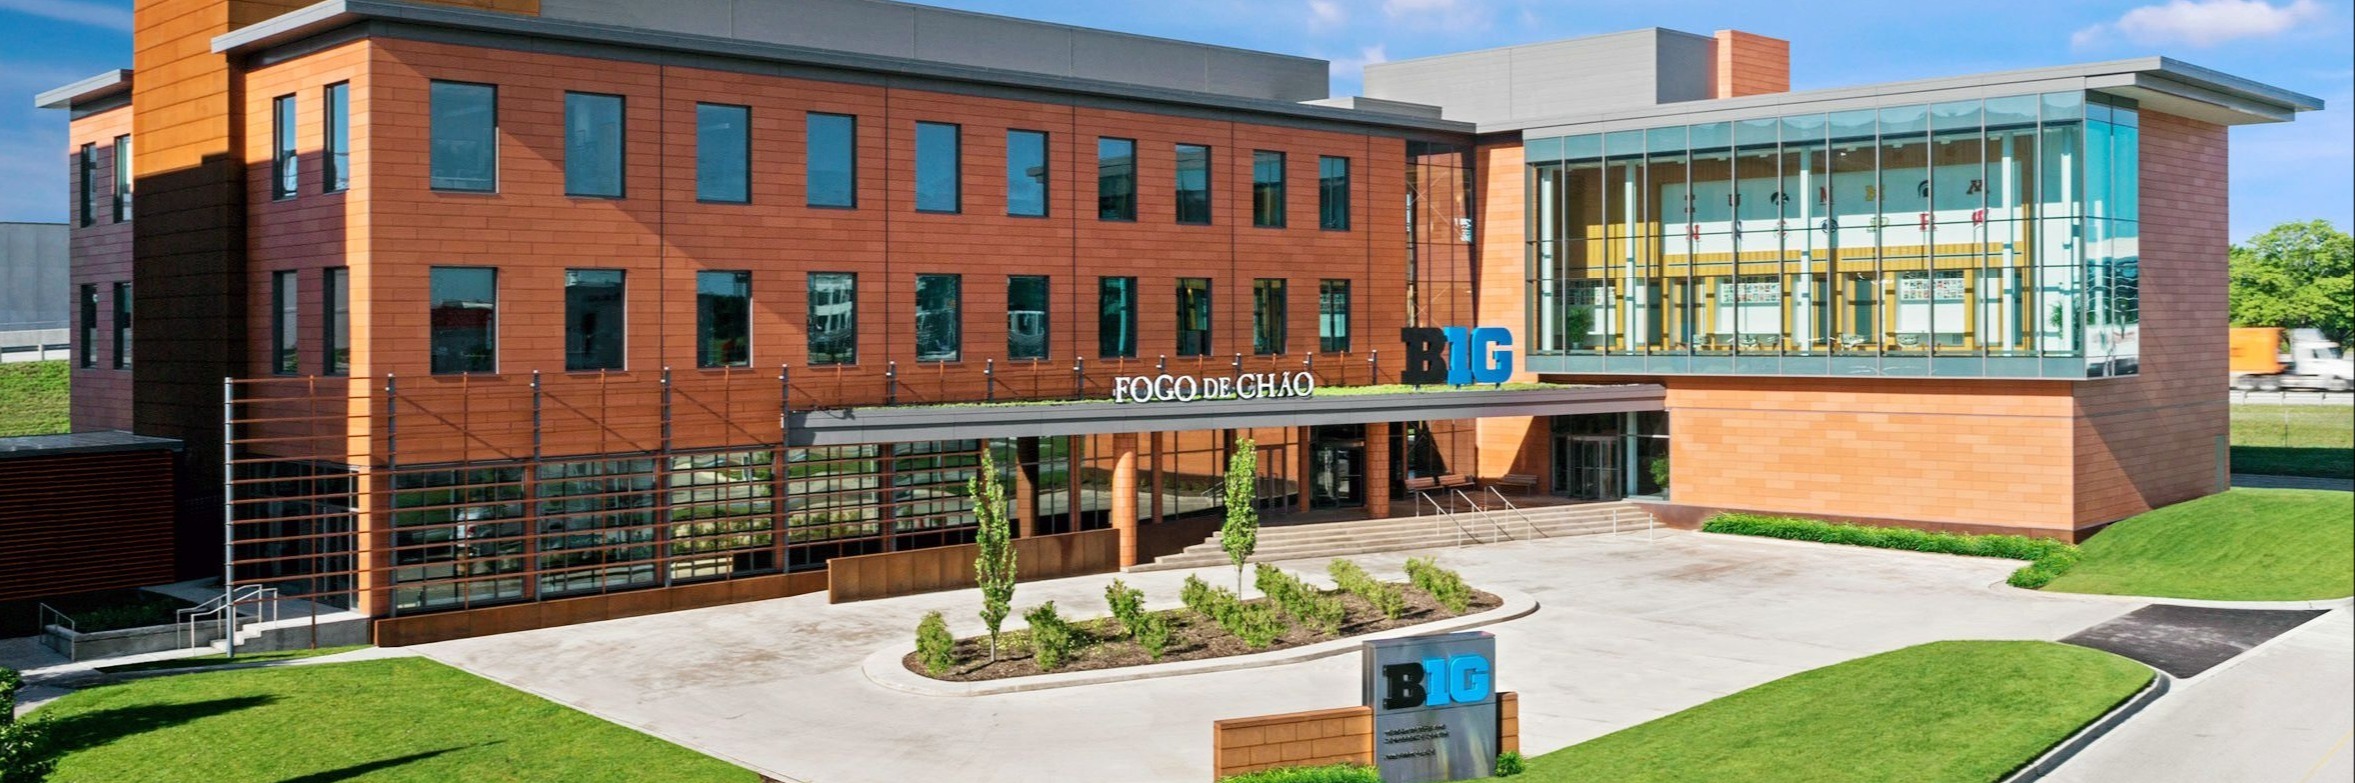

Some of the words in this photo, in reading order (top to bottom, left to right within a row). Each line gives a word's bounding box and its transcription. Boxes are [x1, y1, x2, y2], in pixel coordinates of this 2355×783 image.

[1114, 374, 1197, 403] FOGO
[1203, 377, 1231, 398] DE
[1236, 371, 1314, 398] CHÃO
